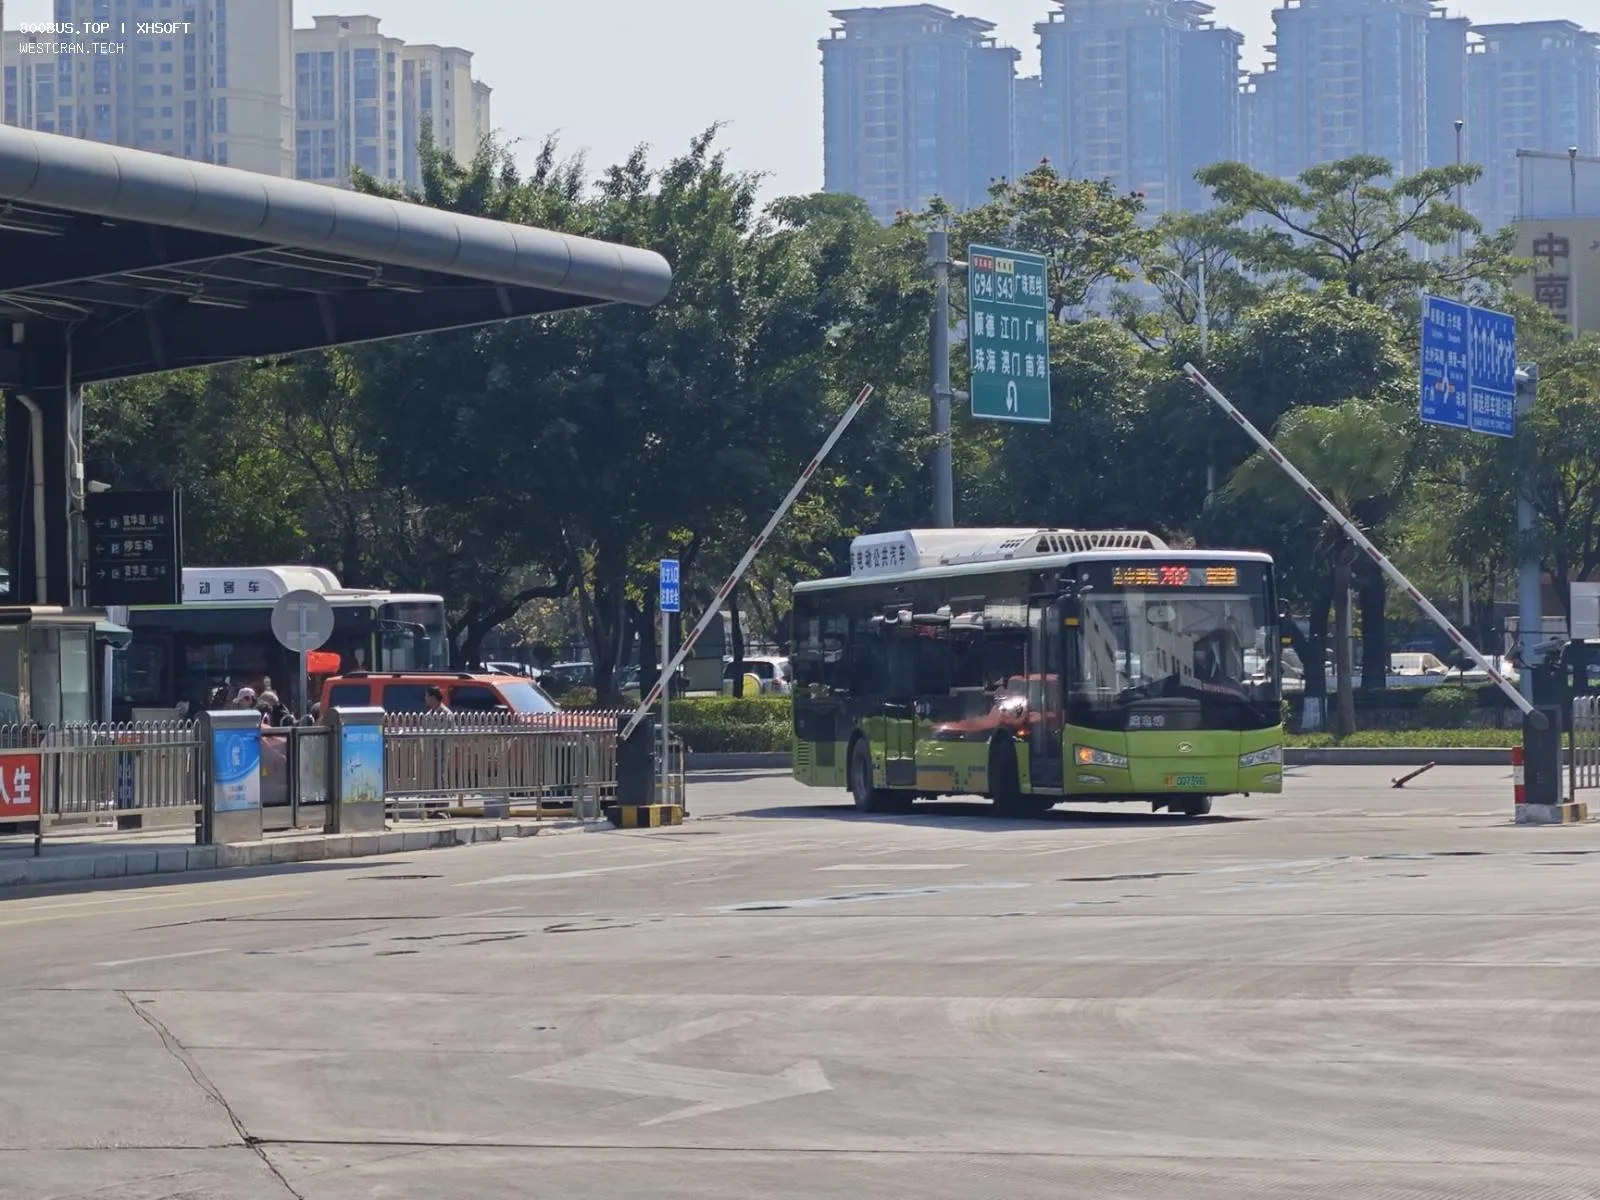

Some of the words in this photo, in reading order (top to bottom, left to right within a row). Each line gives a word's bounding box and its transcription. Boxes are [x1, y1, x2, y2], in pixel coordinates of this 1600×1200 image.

[974, 272, 993, 297] G94
[997, 275, 1013, 299] S43
[1533, 232, 1569, 323] 中南
[974, 311, 996, 338] 顺德
[1000, 314, 1020, 341] 江门
[1025, 317, 1045, 344] 广州
[974, 347, 996, 374] 珠海
[1001, 349, 1021, 377] 澳门
[1025, 352, 1046, 379] 南海
[181, 580, 260, 595] 动客车
